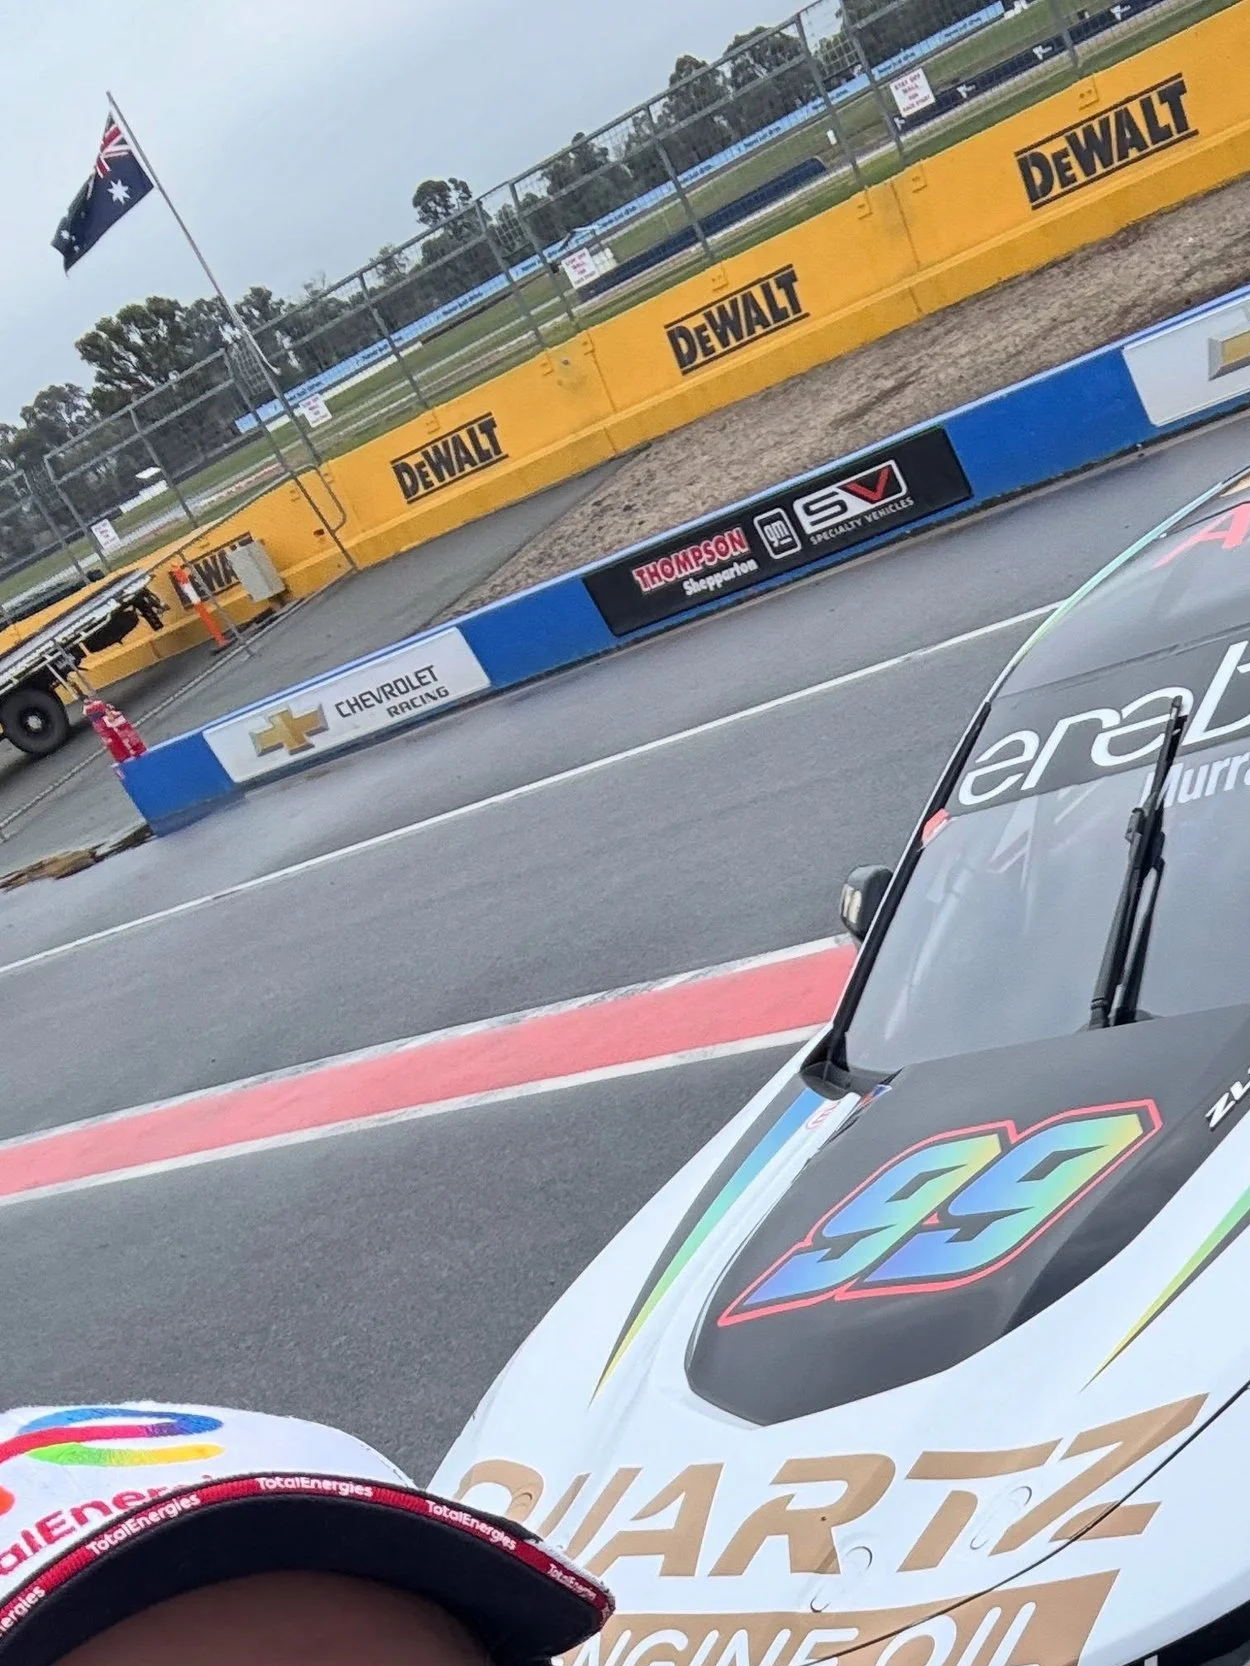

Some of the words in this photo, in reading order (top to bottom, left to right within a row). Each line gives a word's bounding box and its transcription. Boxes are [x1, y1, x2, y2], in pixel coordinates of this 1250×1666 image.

[632, 526, 749, 594] THOMPSON
[682, 558, 758, 596] Shepparton
[334, 665, 439, 719] CHEVROLET
[386, 685, 450, 718] RACING
[714, 1098, 1163, 1327] 99
[256, 1475, 373, 1498] TotalEnergies
[86, 1493, 201, 1556] TotalEnergies
[425, 1500, 517, 1551] TotalEnergies
